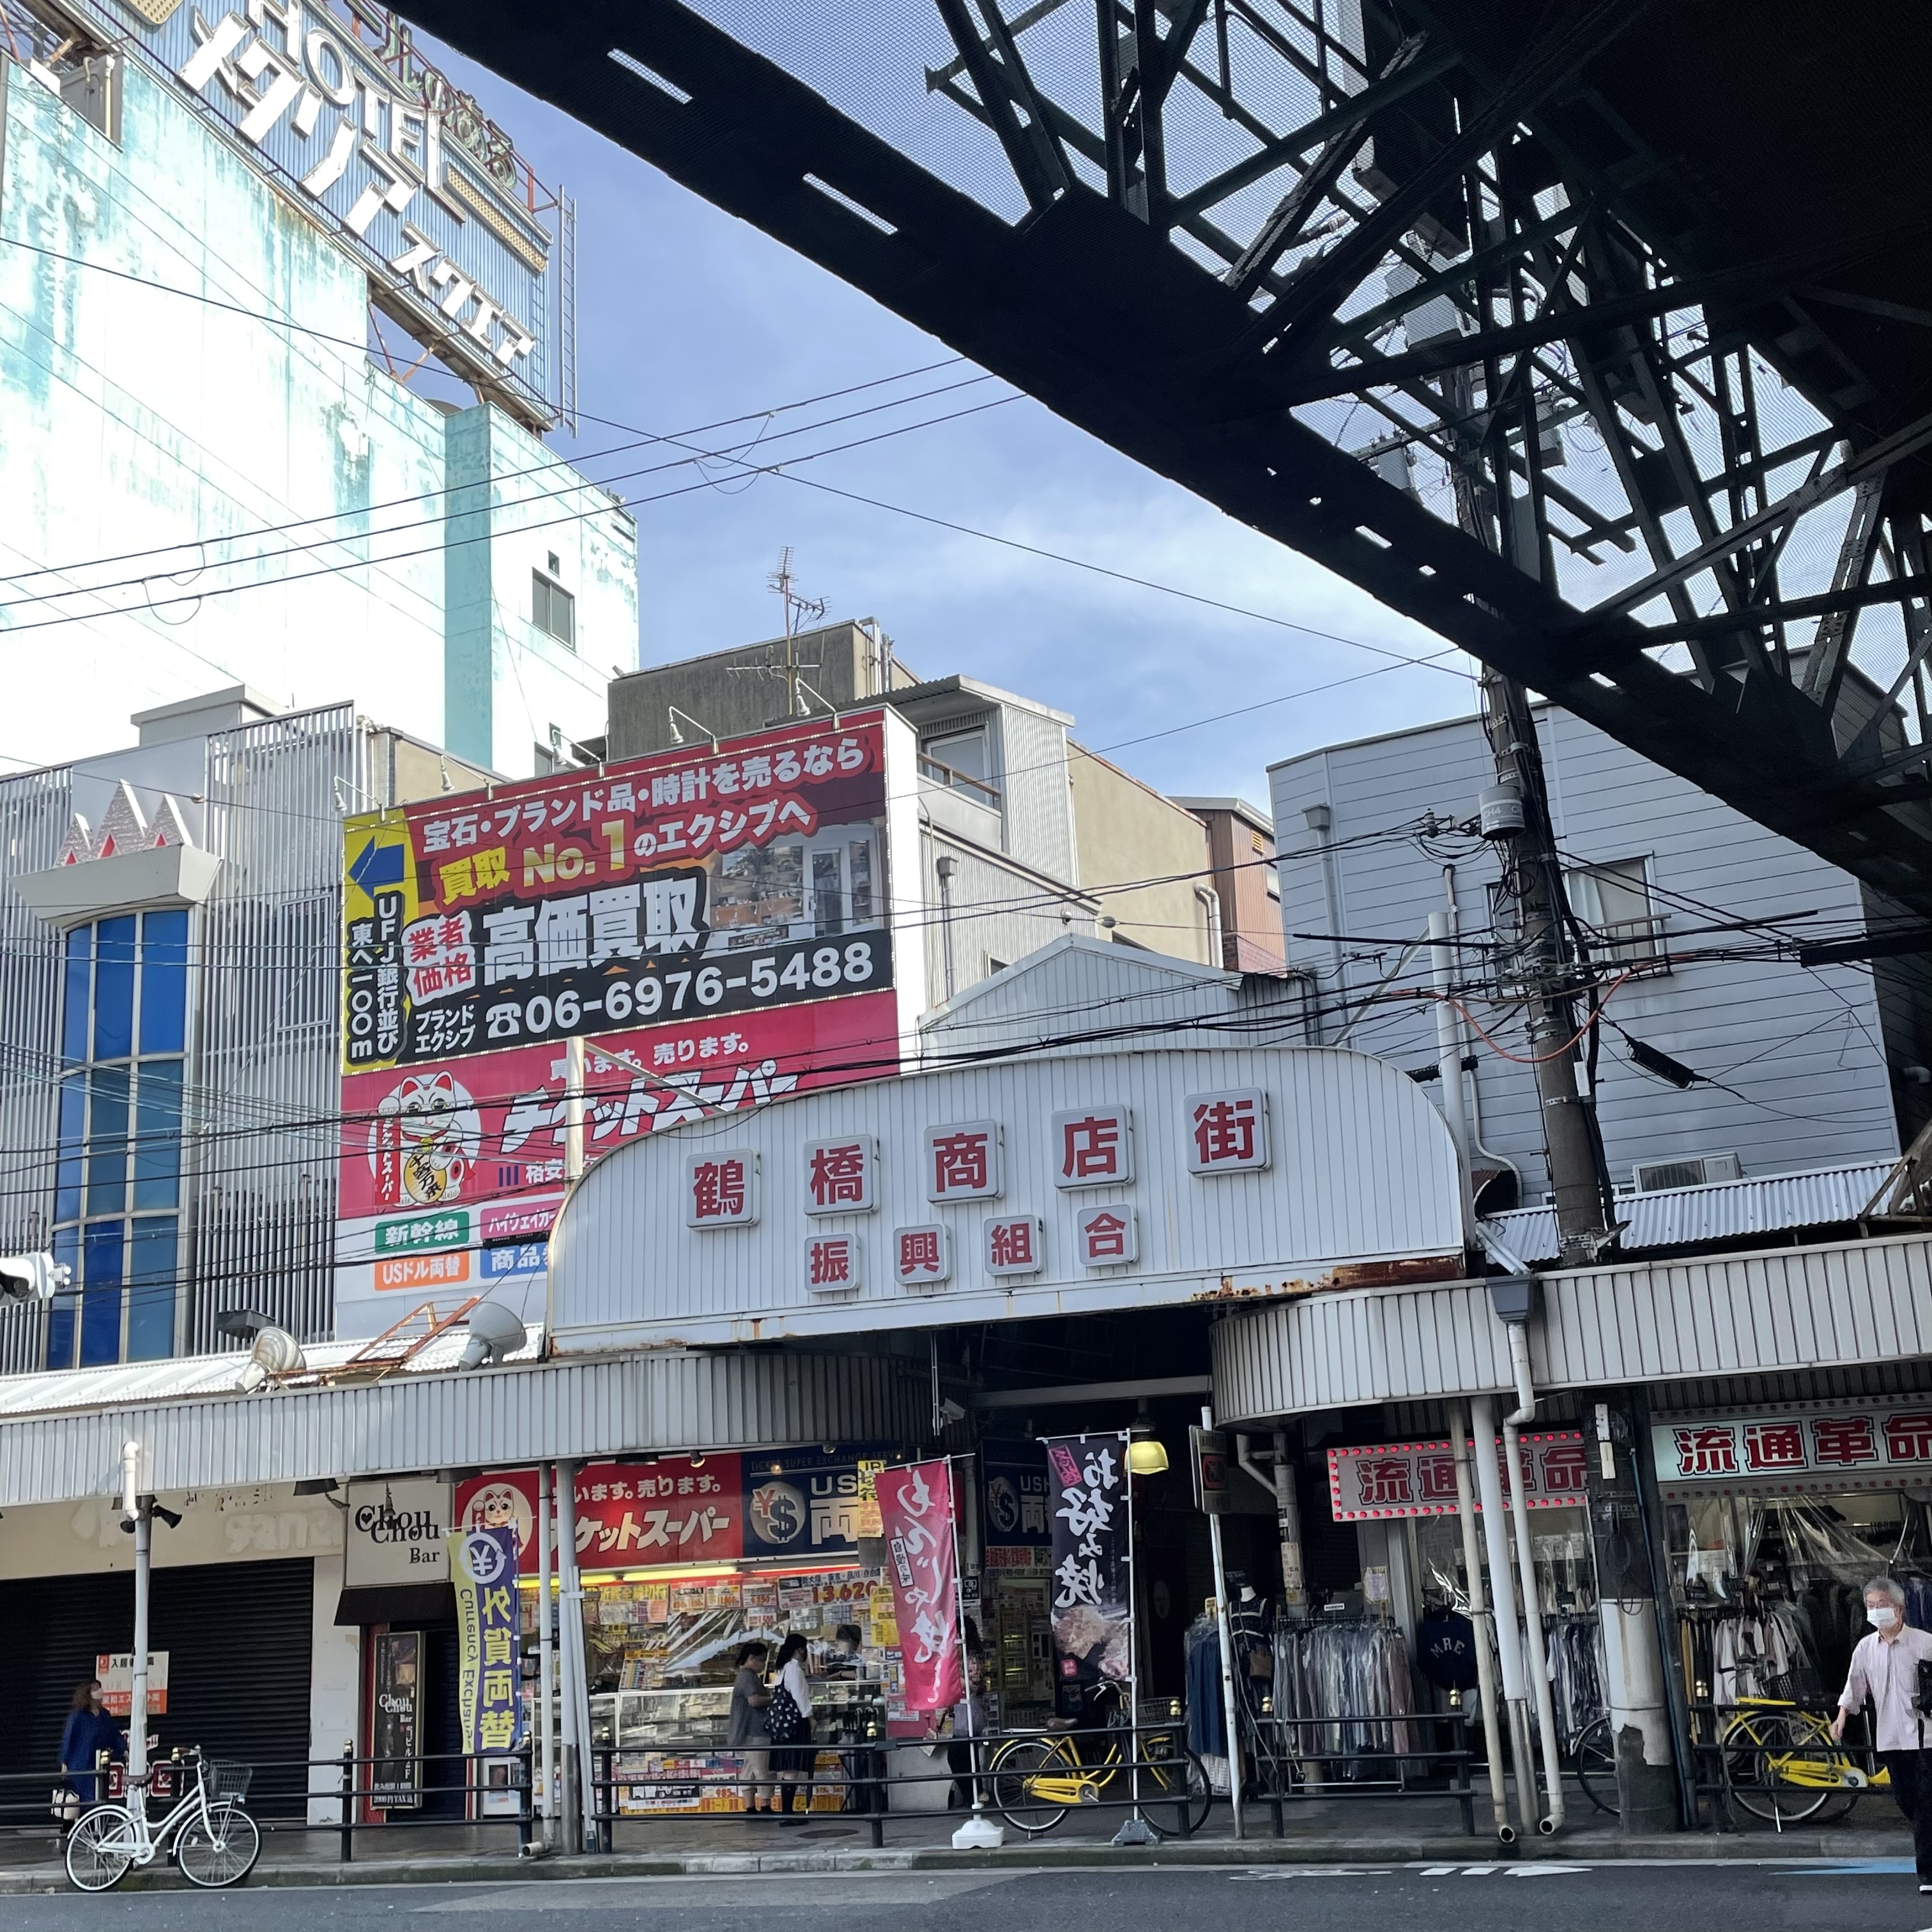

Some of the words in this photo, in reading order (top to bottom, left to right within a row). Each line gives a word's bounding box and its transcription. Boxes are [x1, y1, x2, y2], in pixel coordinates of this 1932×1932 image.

[440, 846, 510, 905] 買取
[408, 917, 464, 963] 業者
[483, 877, 701, 986] 高価買取
[413, 953, 471, 998] 価格
[525, 942, 873, 1034] 06-6976-5488
[415, 1004, 475, 1033] ブランド
[415, 1025, 476, 1054] エクシブ
[693, 1100, 1255, 1219] 鶴橋商店街
[385, 1218, 459, 1246] 新幹線
[810, 1213, 1126, 1284] 振興組合
[491, 1243, 549, 1271] 商品
[1671, 1410, 1932, 1476] 流通革命
[552, 1474, 721, 1505] います。売ります。
[551, 1506, 730, 1553] ケットスーパー
[409, 1547, 440, 1564] Bar
